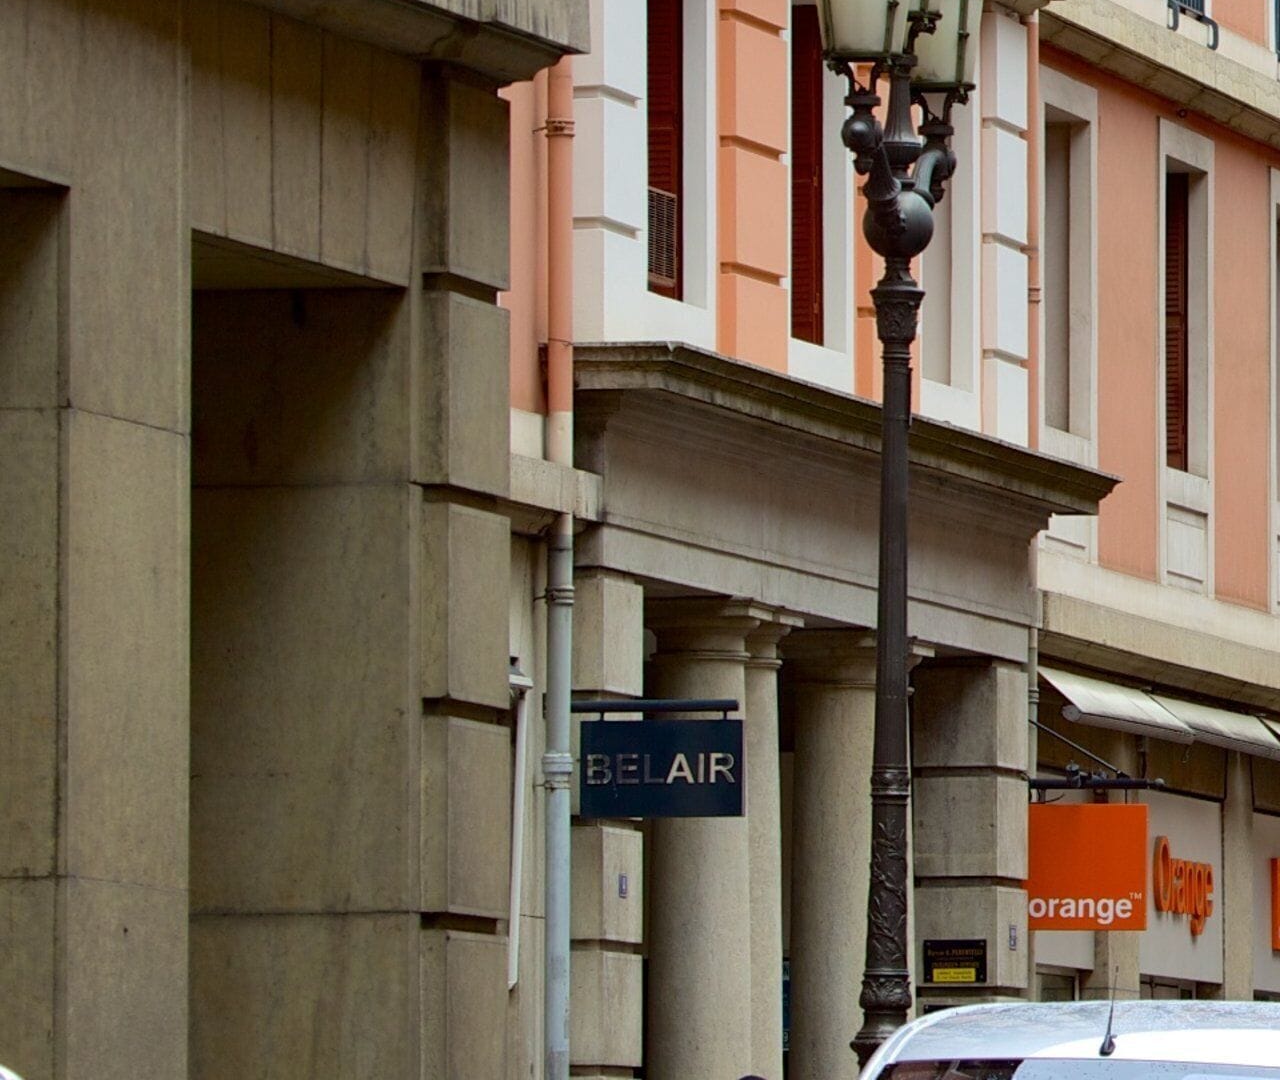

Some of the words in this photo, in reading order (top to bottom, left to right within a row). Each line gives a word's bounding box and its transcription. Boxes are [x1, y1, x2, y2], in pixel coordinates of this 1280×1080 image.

[586, 752, 736, 785] BELAIR
[1153, 835, 1214, 936] Orange
[1028, 896, 1132, 925] orange
